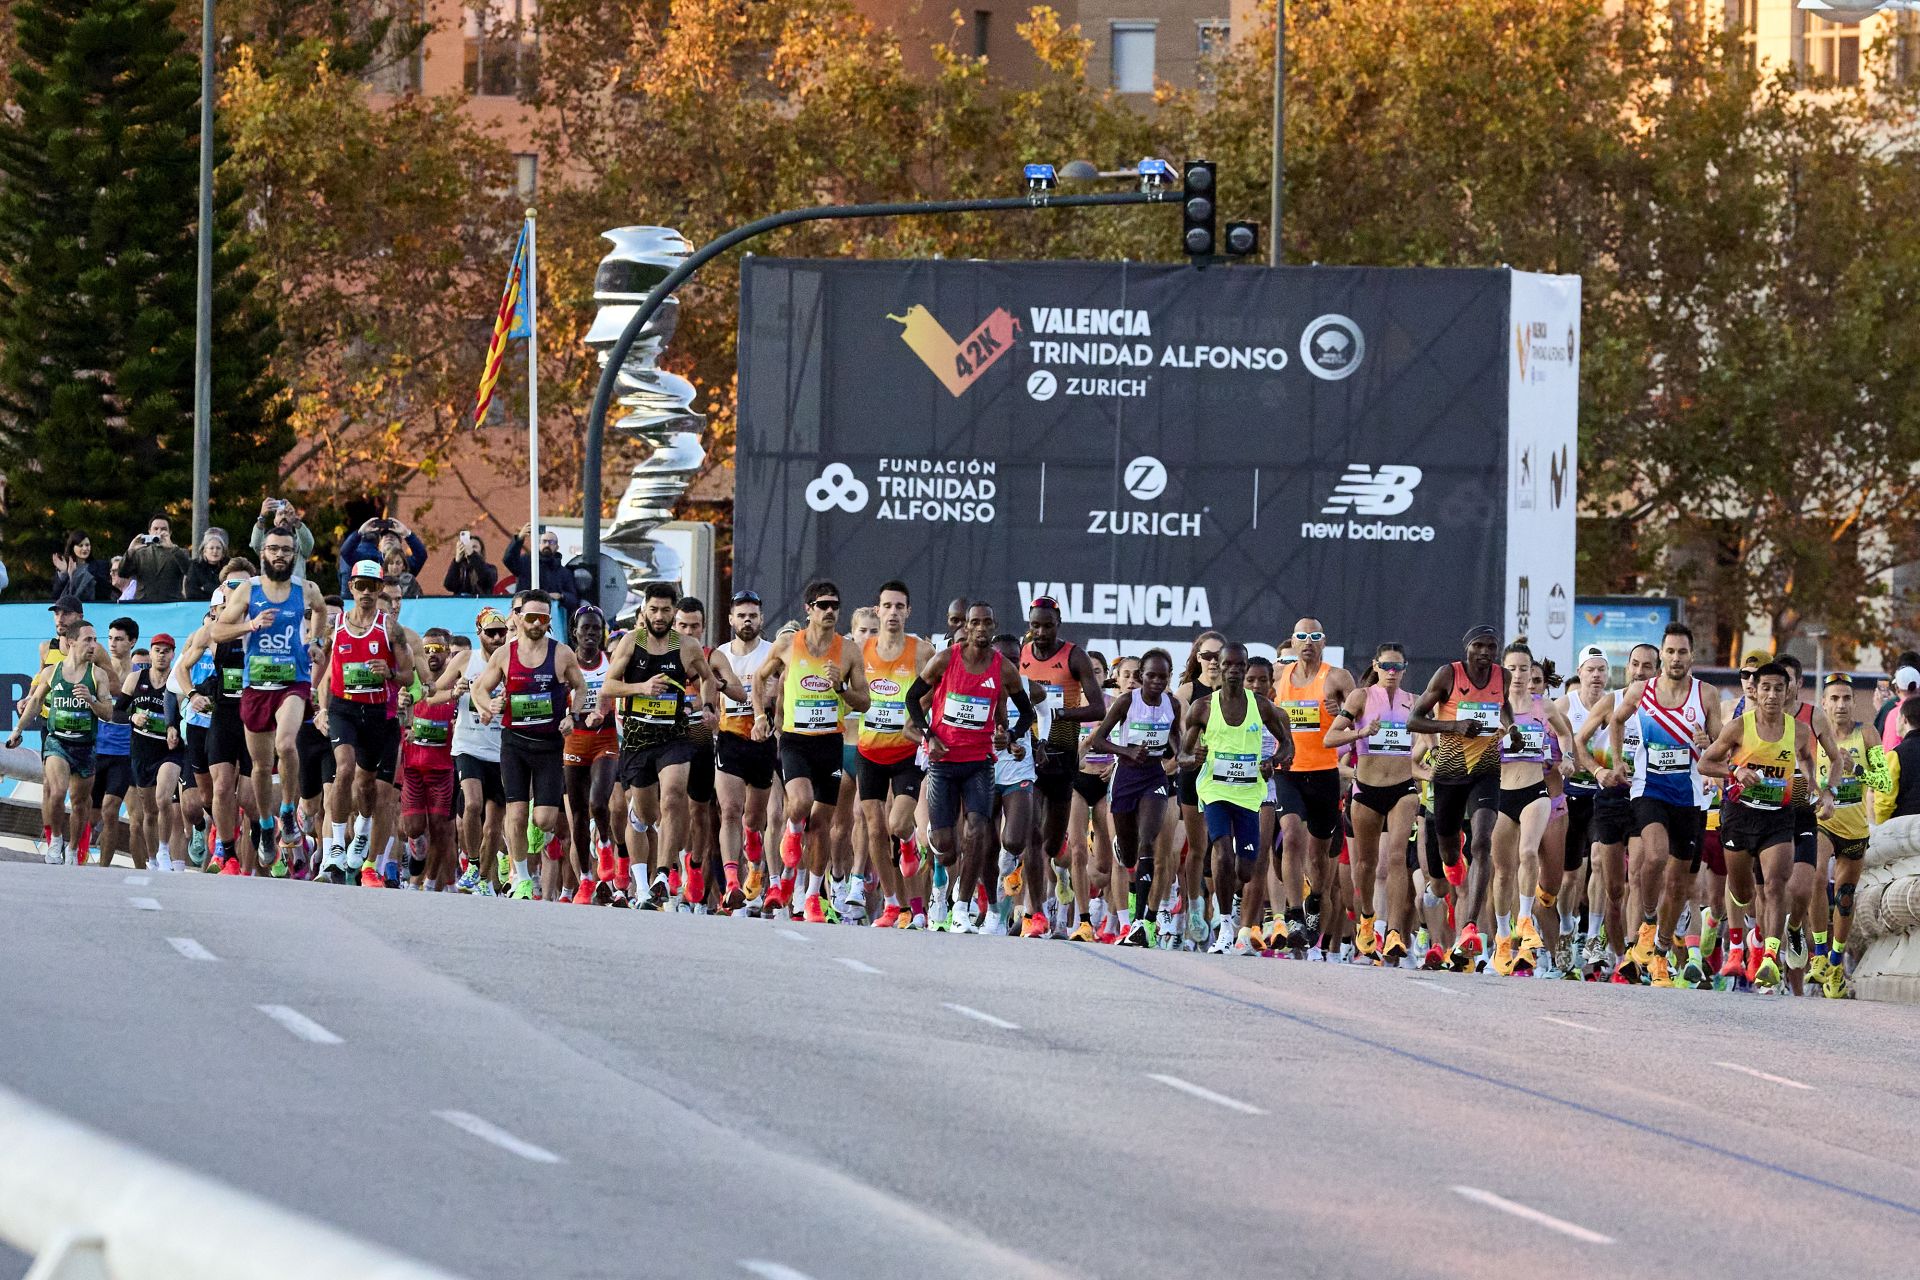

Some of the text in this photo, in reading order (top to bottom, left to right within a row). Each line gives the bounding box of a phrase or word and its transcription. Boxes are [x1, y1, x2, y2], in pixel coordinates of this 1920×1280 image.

[1030, 307, 1151, 337] VALENCIA
[955, 326, 1002, 380] 42K
[1030, 341, 1288, 371] TRINIDAD ALFONSO
[1066, 378, 1146, 397] ZURICH
[879, 458, 996, 475] FUNDACIÓN
[877, 477, 996, 501] TRINIDAD
[877, 500, 996, 524] ALFONSO
[1087, 511, 1201, 537] ZURICH
[1301, 520, 1435, 542] new balance
[1017, 581, 1213, 628] VALENCIA
[259, 625, 293, 649] asl
[804, 679, 830, 688] Serrano
[873, 682, 899, 692] Serrano
[53, 697, 91, 708] ETHIOPI
[960, 704, 974, 712] 332
[956, 711, 975, 720] PACER
